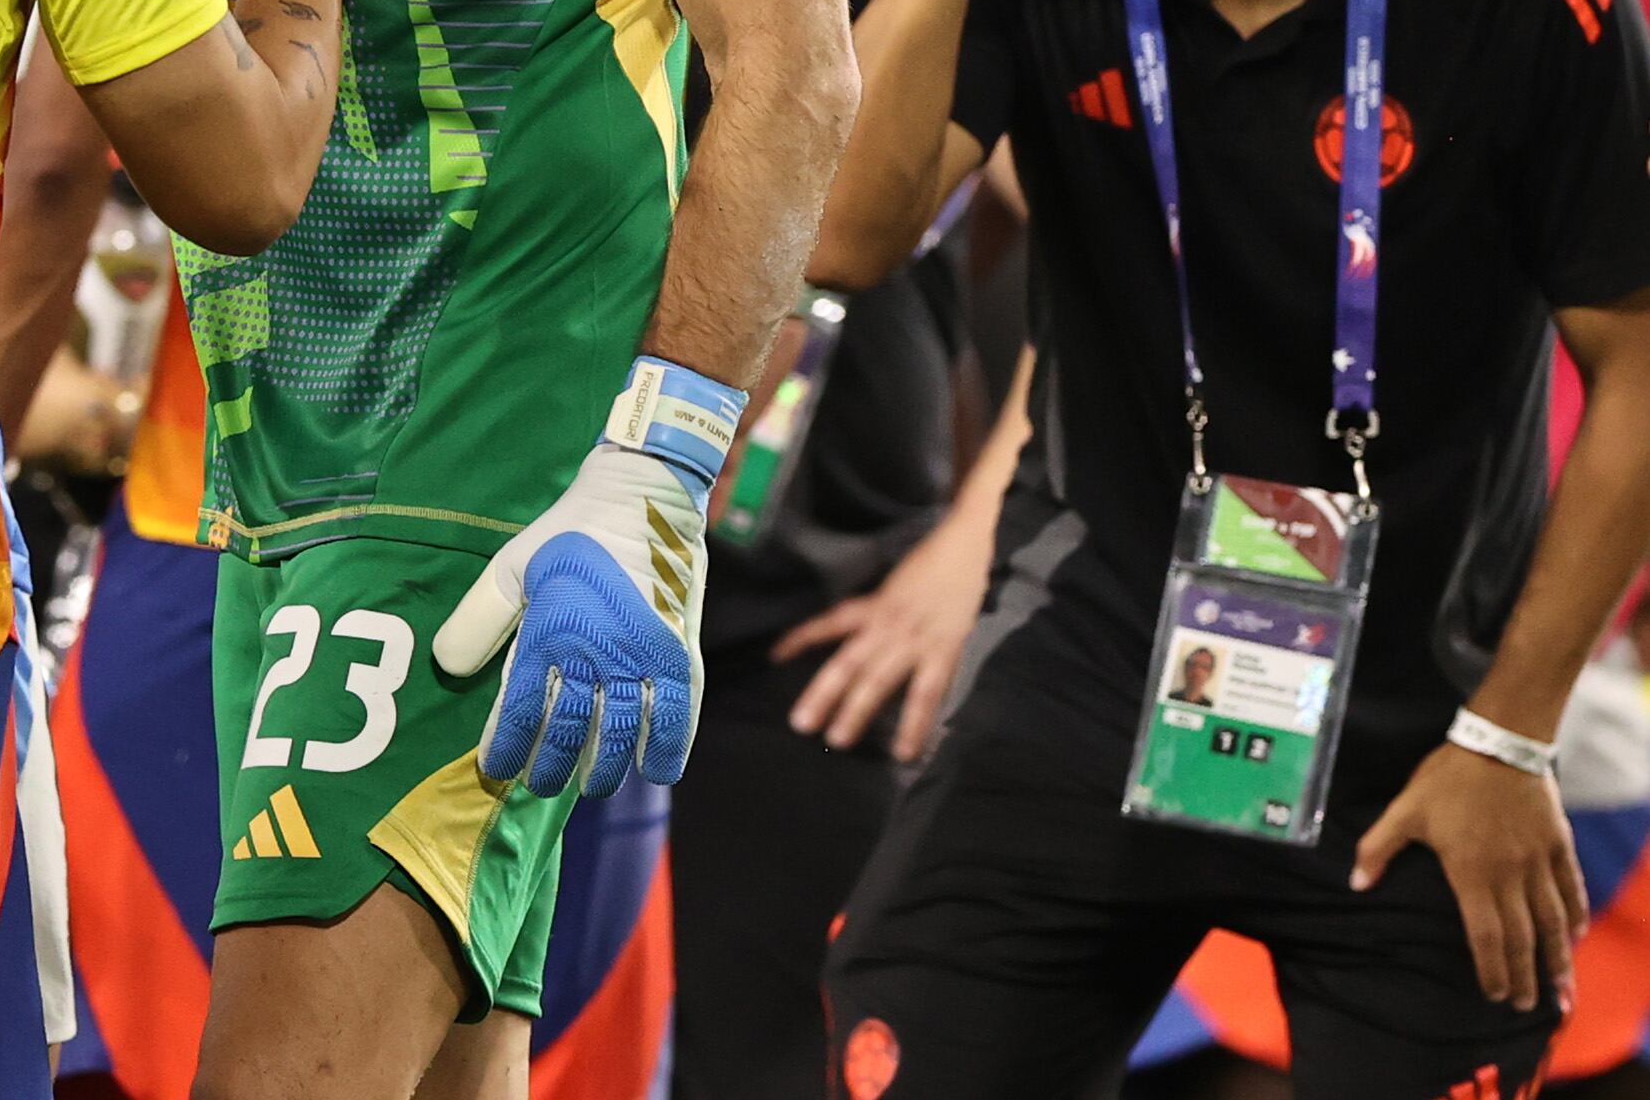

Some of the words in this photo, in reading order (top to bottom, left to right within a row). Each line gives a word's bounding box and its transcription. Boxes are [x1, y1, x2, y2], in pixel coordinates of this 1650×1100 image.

[626, 371, 654, 439] PREDATOR
[698, 419, 706, 428] &
[706, 423, 731, 446] SANTI
[240, 604, 415, 773] 23
